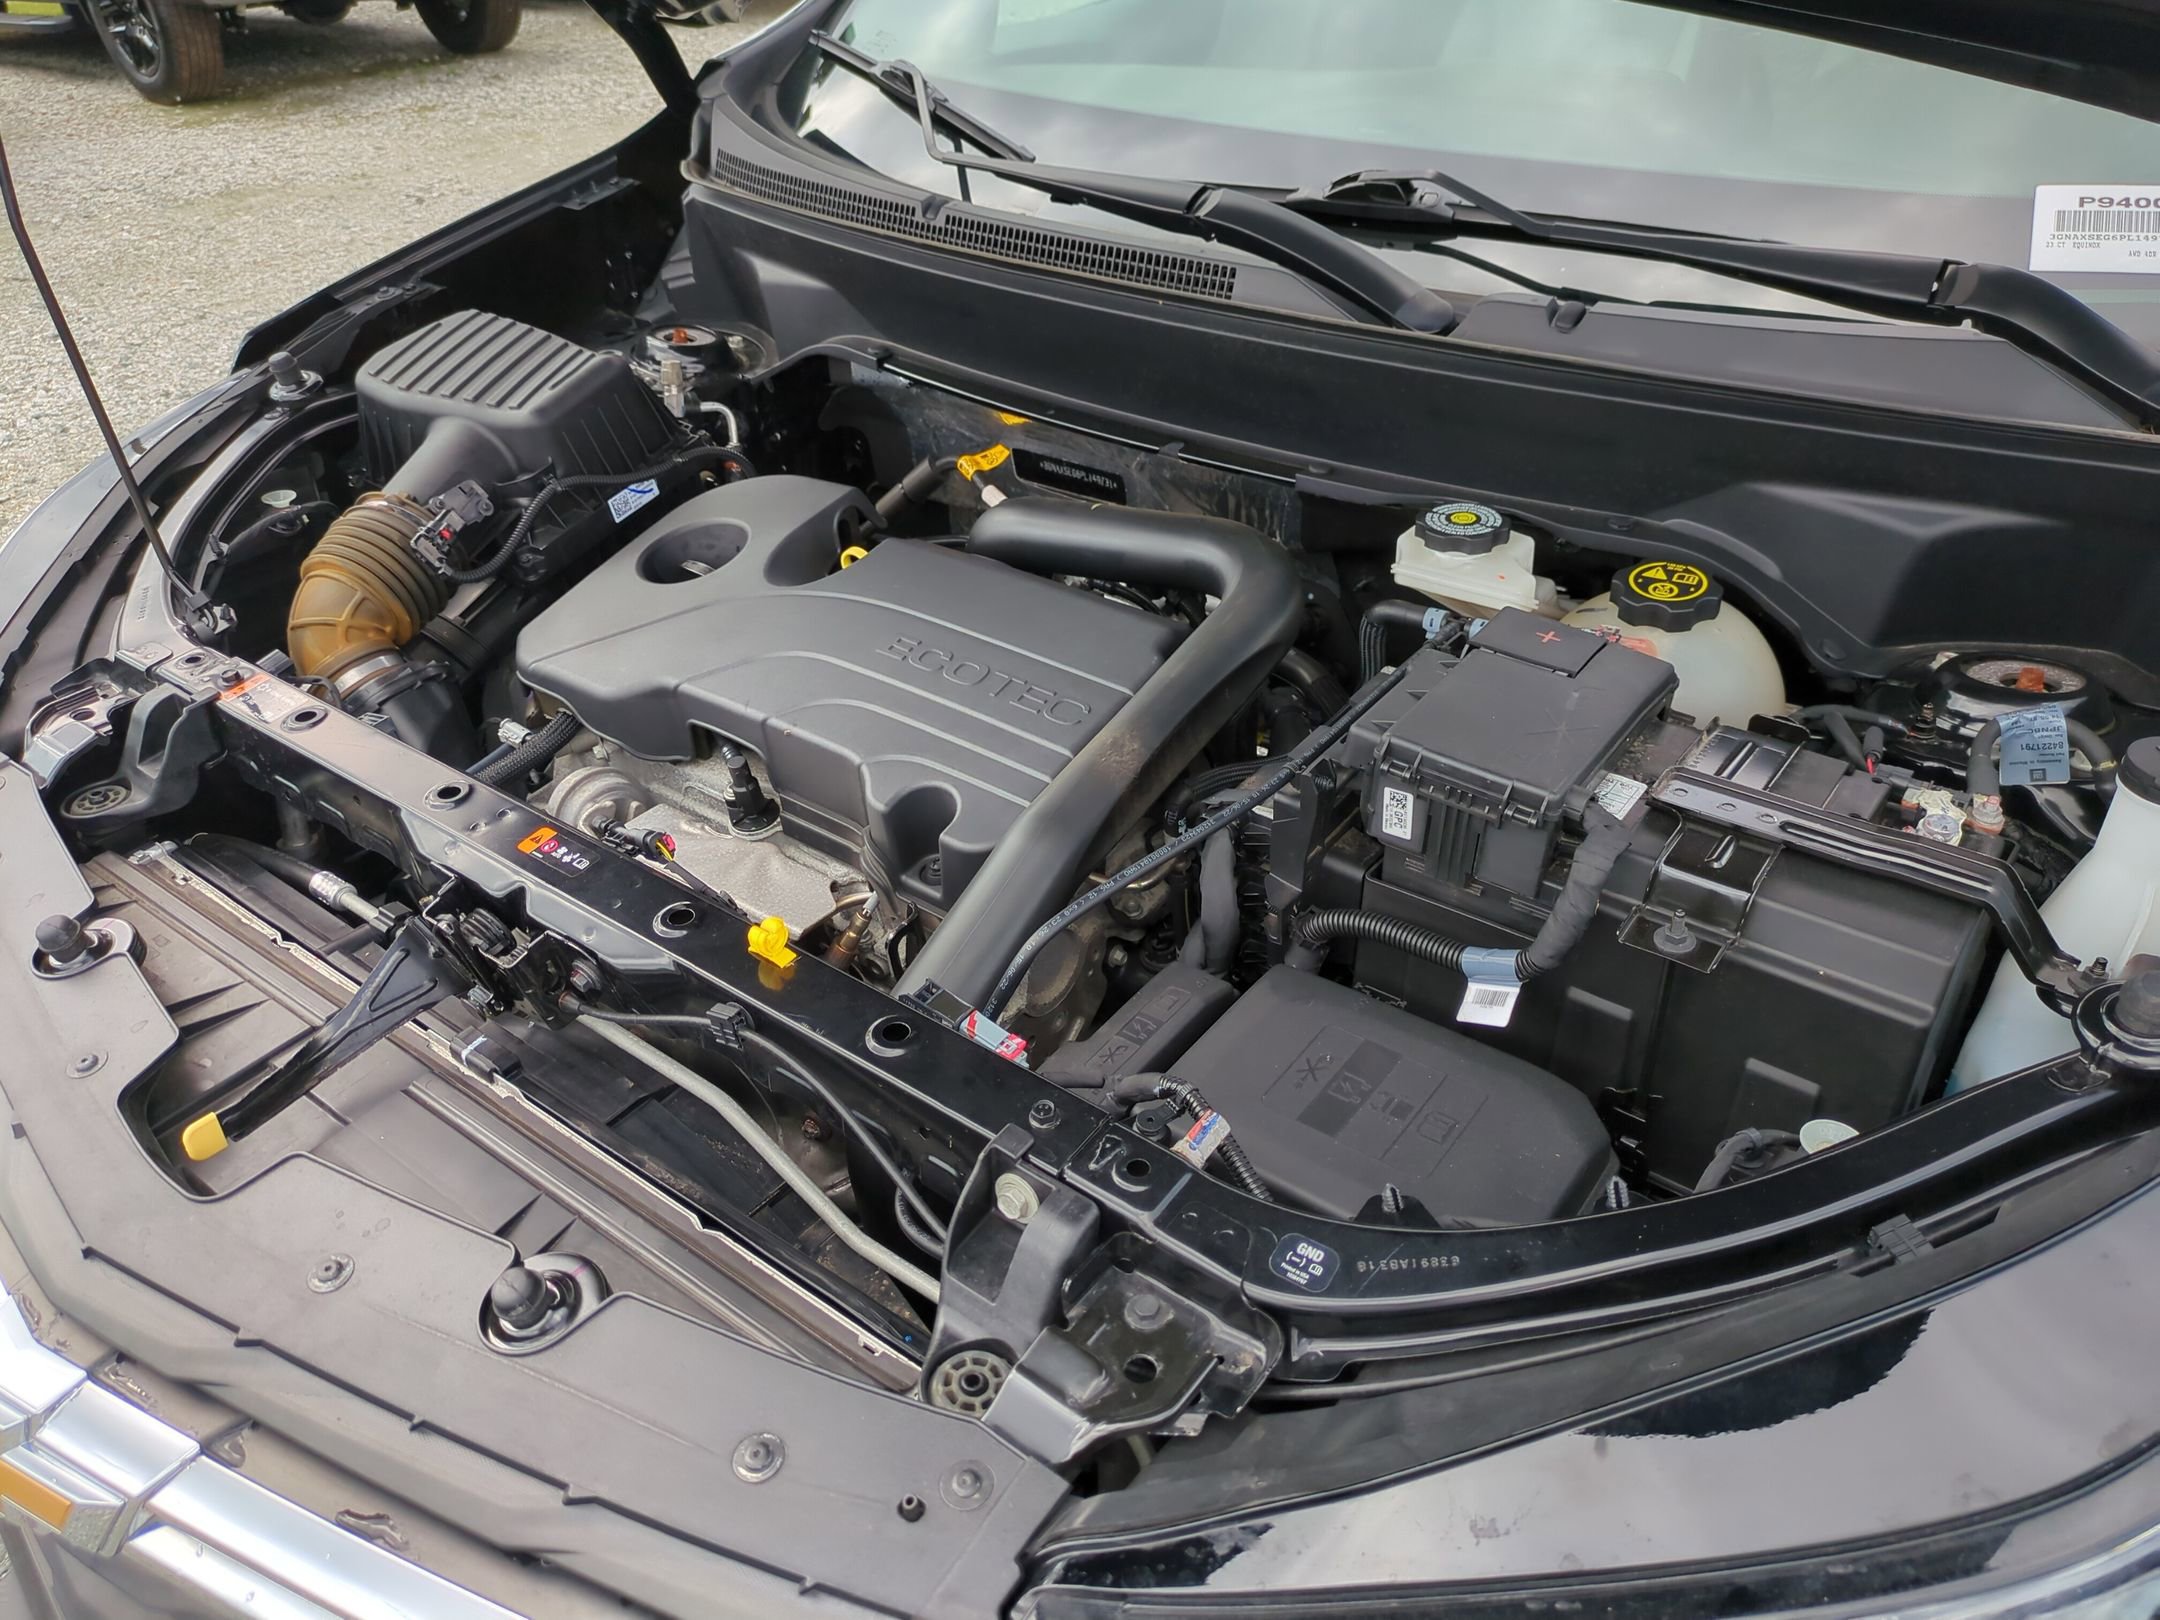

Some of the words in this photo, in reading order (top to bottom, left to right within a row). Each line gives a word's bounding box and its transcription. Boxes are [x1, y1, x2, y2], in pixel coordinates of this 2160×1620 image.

[2049, 233, 2160, 242] 3GNAXSEG6PL149
[874, 631, 1092, 727] ECOTEC
[2020, 741, 2064, 752] 84221791
[1393, 810, 1404, 830] GPC
[1296, 1242, 1325, 1263] GND
